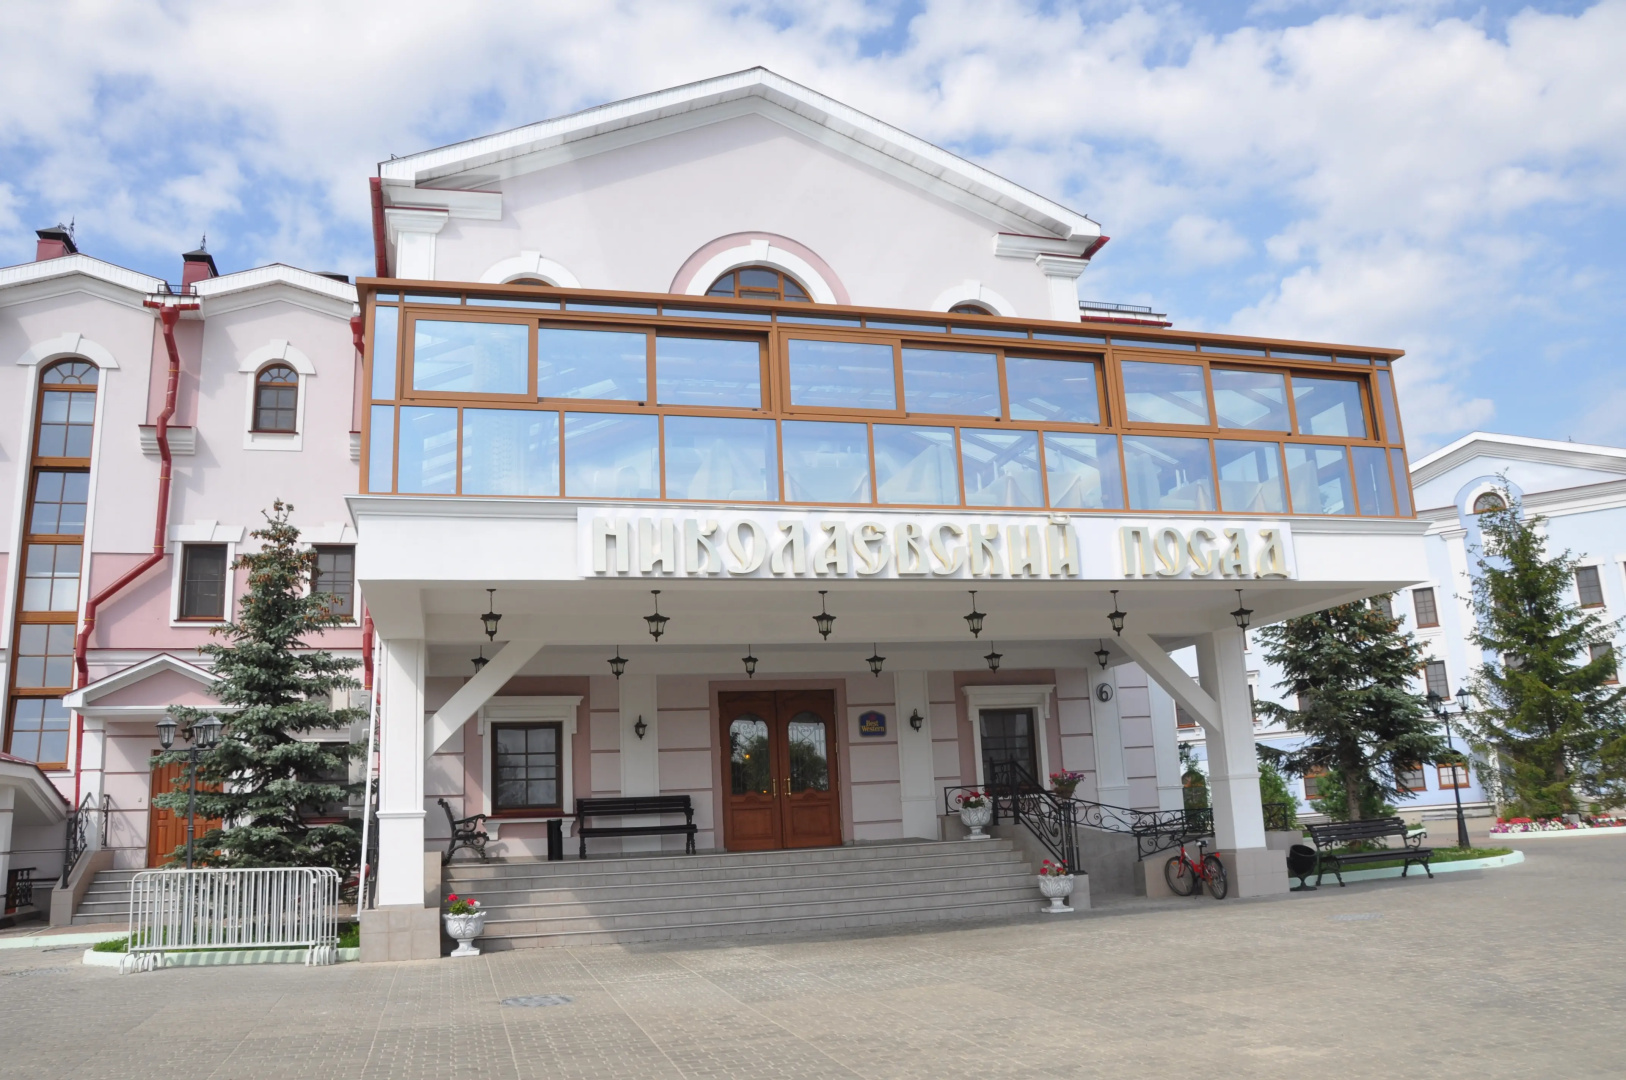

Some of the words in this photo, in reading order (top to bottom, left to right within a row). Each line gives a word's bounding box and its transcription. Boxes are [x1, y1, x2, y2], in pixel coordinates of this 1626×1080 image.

[593, 514, 1080, 577] НИКОЛАЕВСКИЙ
[1119, 526, 1292, 579] ПОСАД
[1099, 683, 1109, 702] 6
[861, 725, 885, 733] Western
[866, 719, 880, 727] Best
